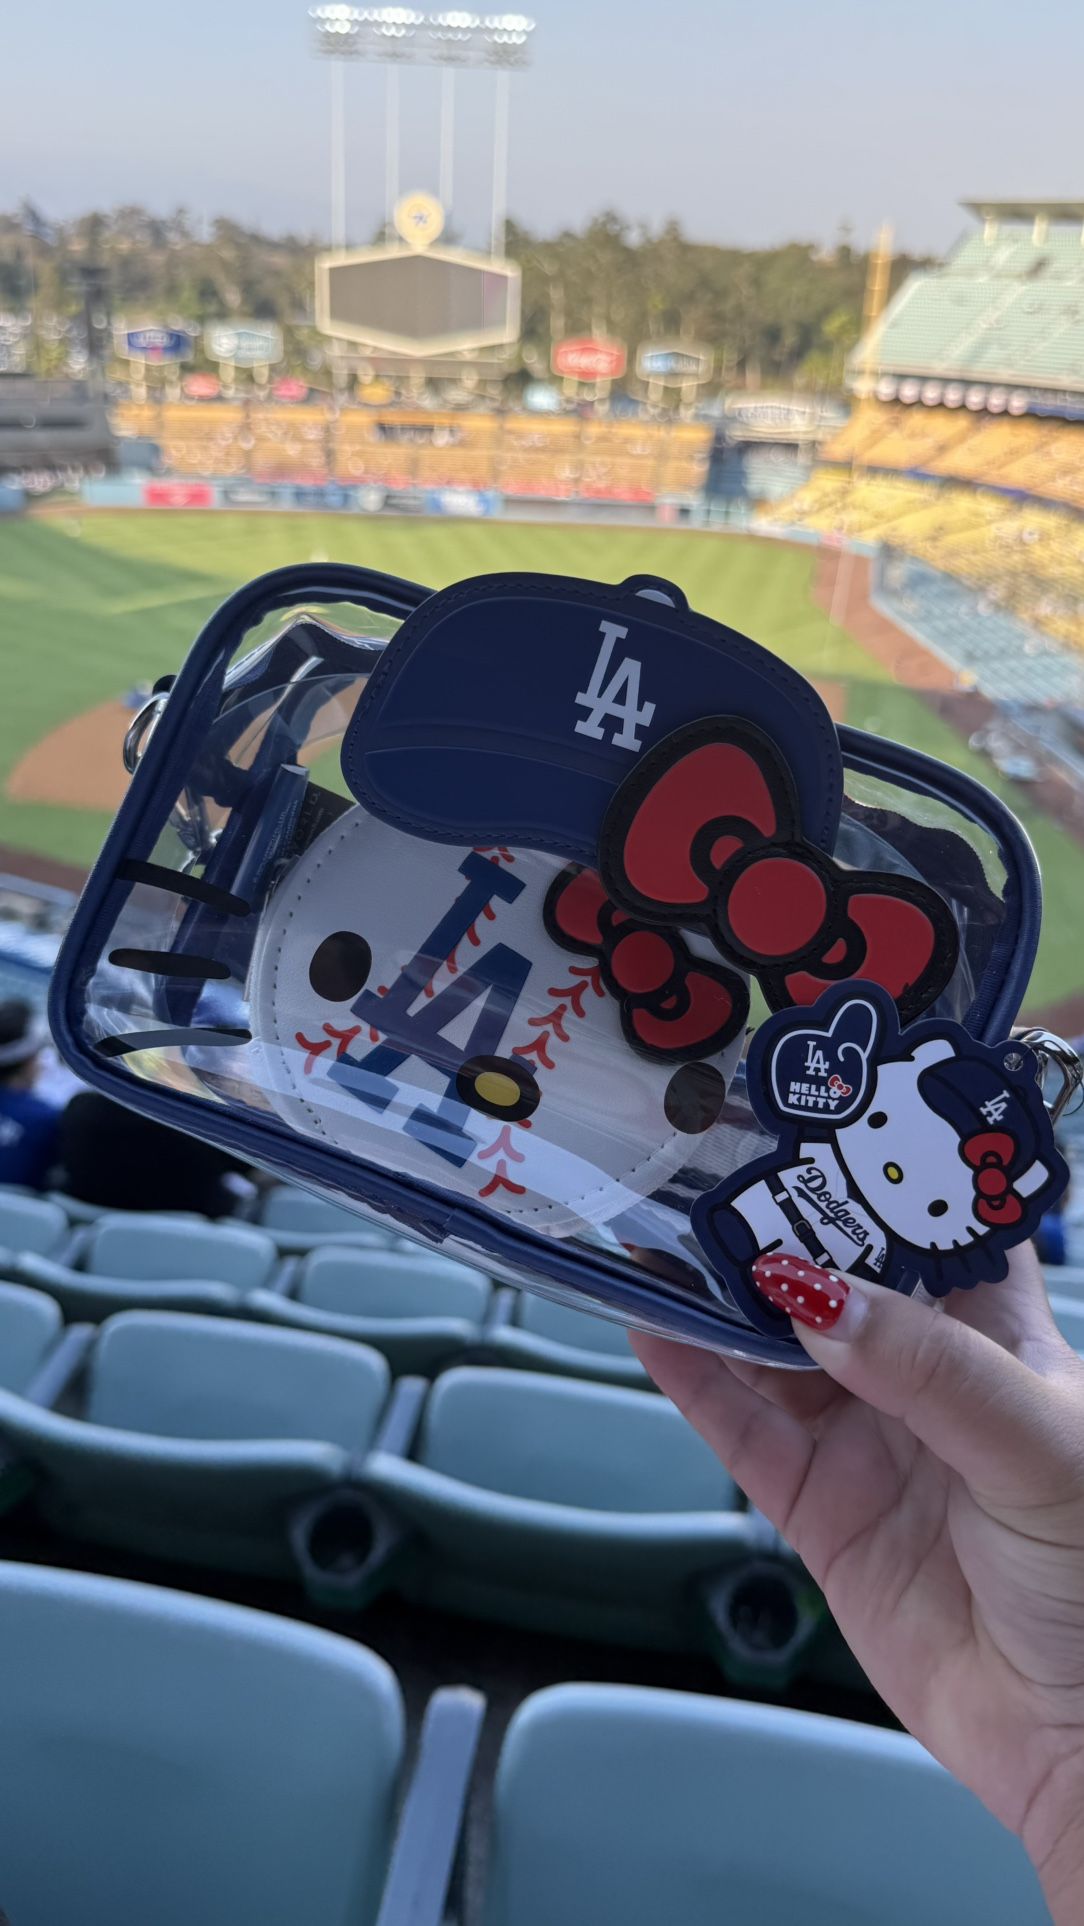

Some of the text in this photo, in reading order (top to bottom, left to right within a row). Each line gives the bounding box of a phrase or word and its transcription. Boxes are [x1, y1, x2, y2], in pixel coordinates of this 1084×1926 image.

[574, 620, 656, 752] LA
[328, 851, 537, 1168] LA
[804, 1041, 830, 1077] LA
[788, 1093, 839, 1111] KITTY
[789, 1081, 841, 1099] HELLO
[979, 1089, 1010, 1125] LA
[794, 1166, 870, 1247] Dodgers
